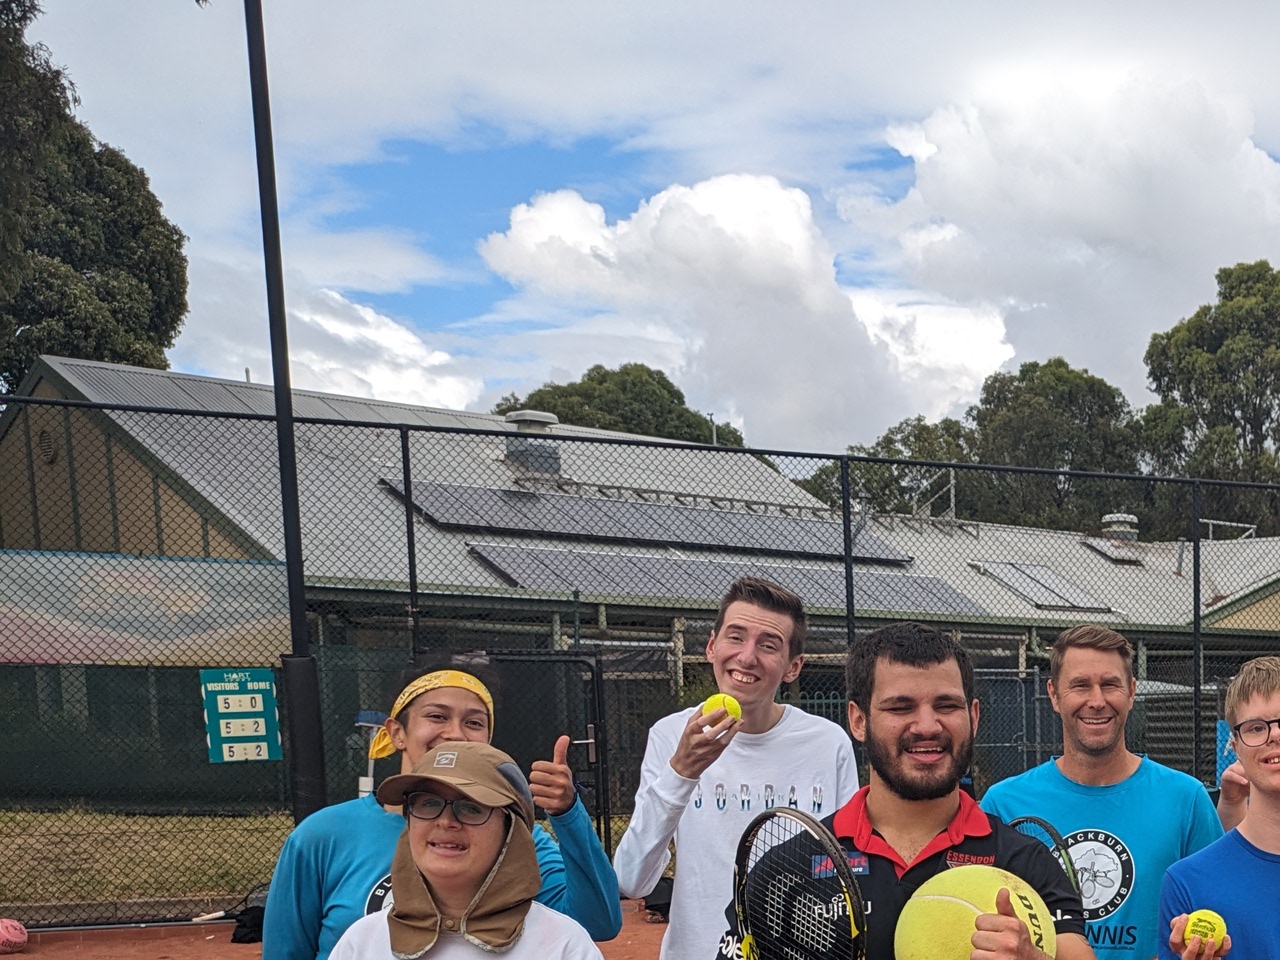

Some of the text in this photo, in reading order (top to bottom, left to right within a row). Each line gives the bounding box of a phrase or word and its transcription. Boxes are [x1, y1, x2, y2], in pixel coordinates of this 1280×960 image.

[207, 681, 271, 691] VISITORS HOME
[224, 697, 231, 710] 5
[250, 696, 257, 709] 0
[225, 722, 232, 734] 5
[253, 721, 260, 733] 2
[228, 746, 235, 758] 5
[255, 744, 262, 757] 2
[694, 783, 823, 813] JORDAN
[946, 850, 995, 864] ESSENDON
[1098, 887, 1128, 915] CLUB
